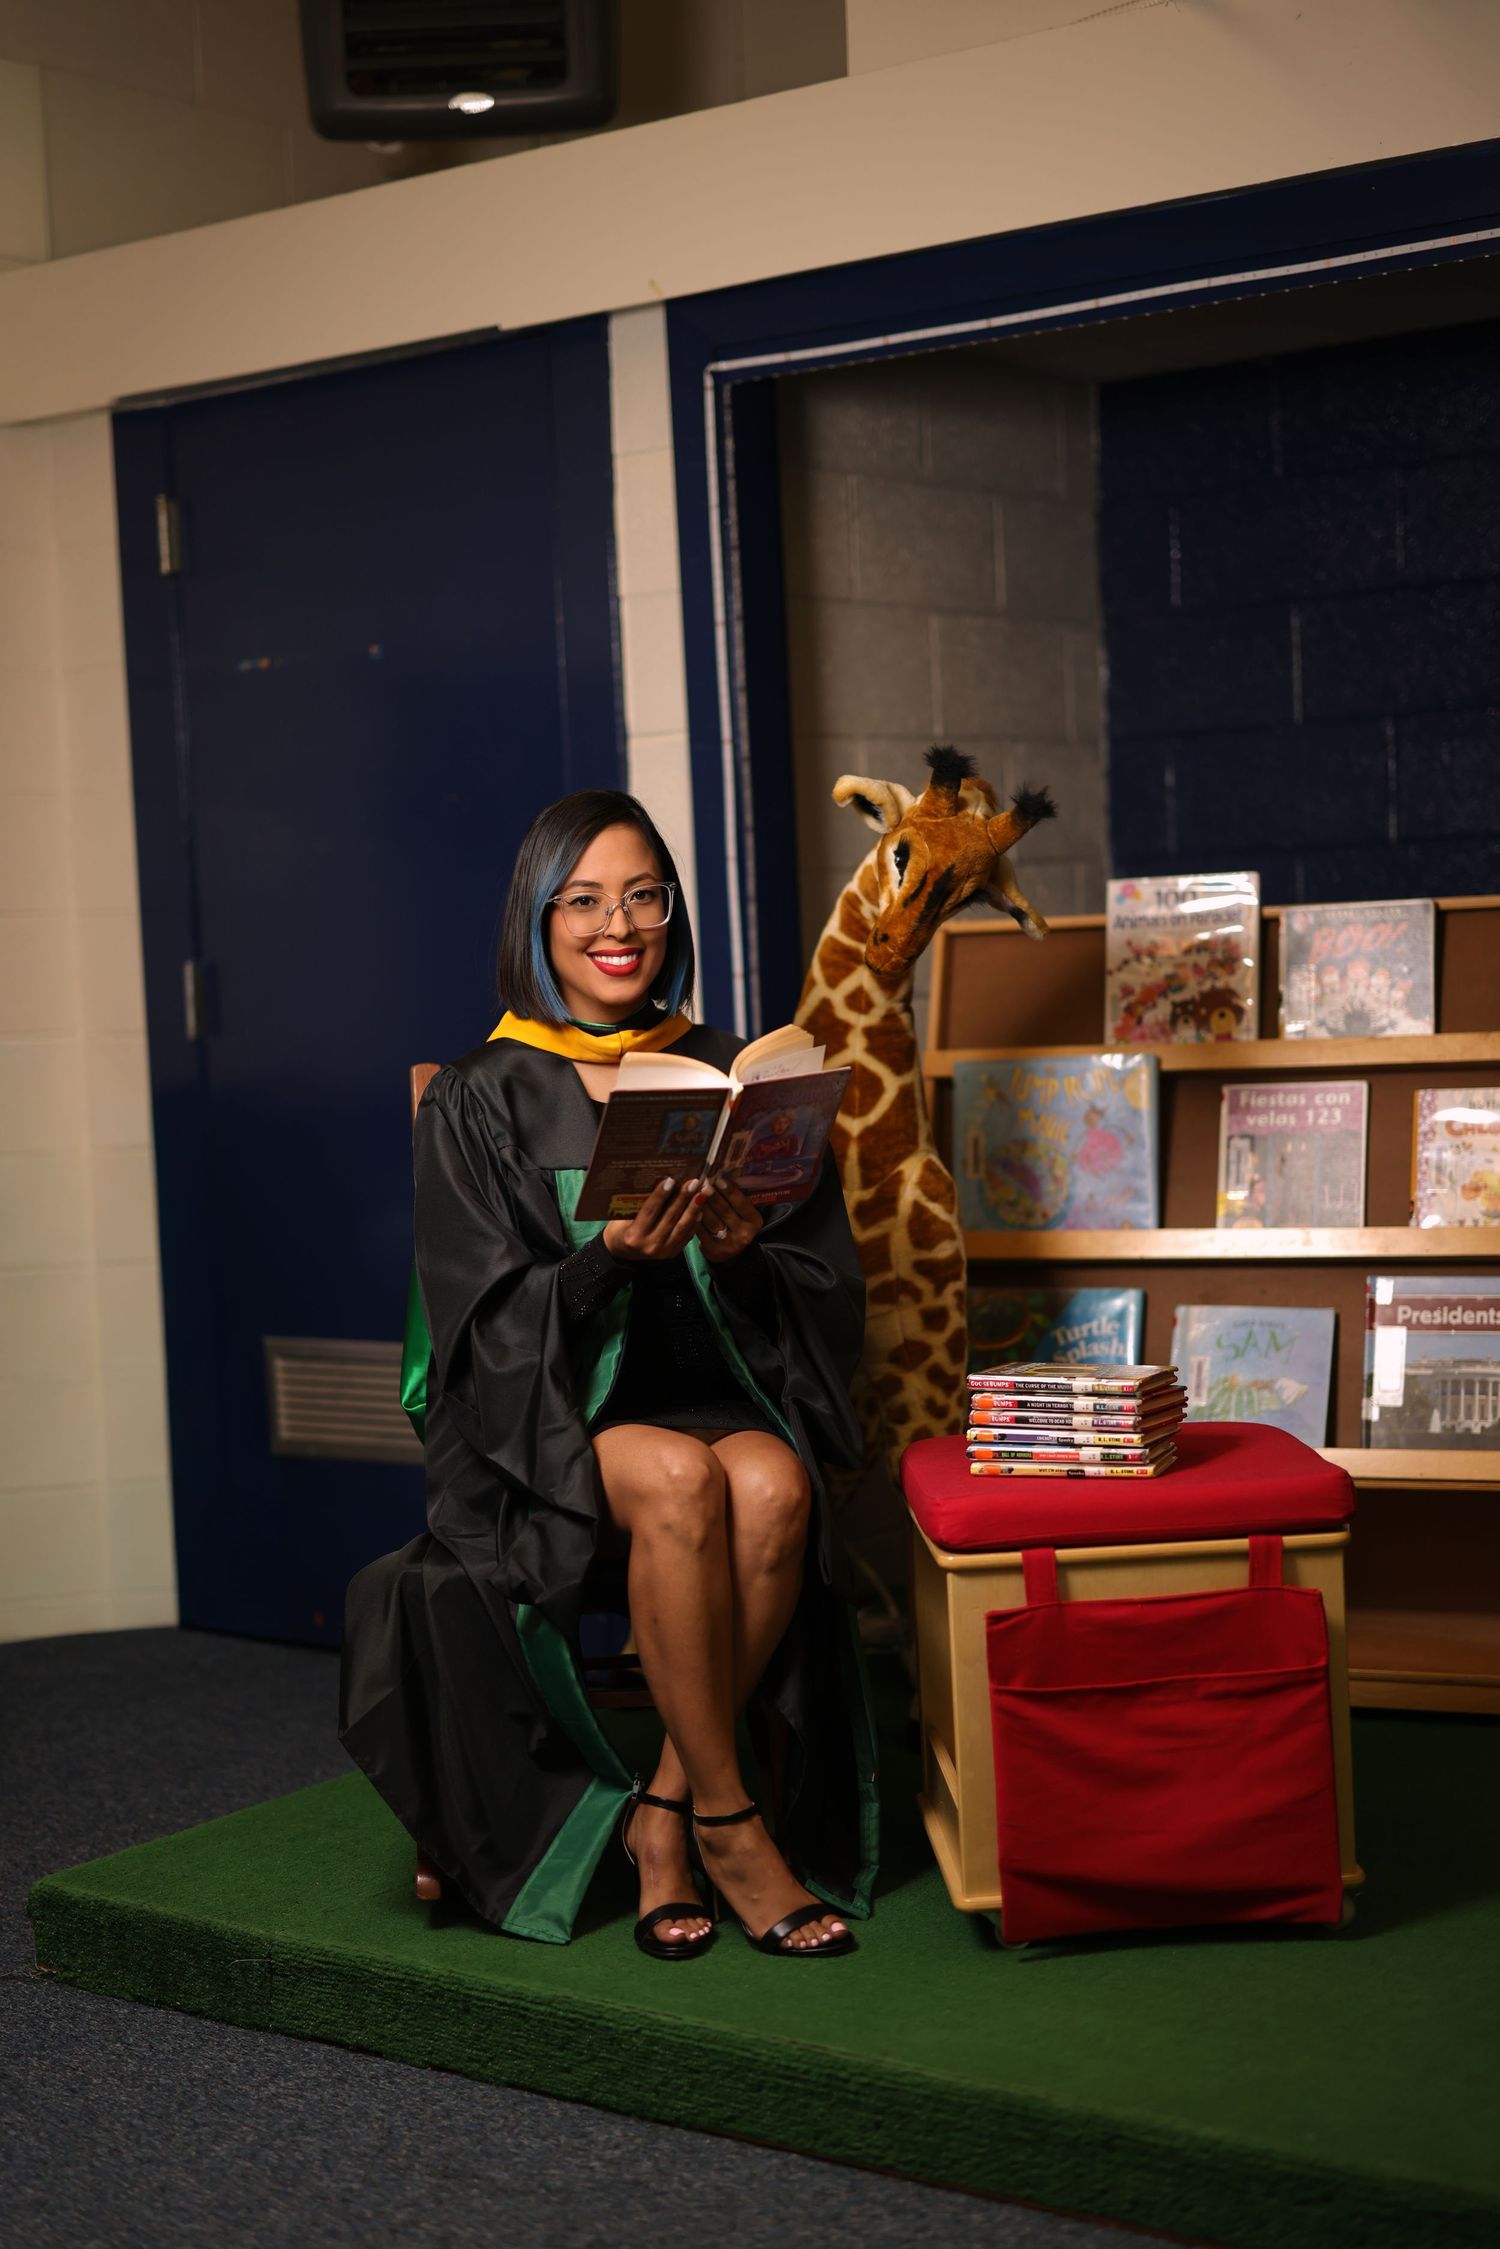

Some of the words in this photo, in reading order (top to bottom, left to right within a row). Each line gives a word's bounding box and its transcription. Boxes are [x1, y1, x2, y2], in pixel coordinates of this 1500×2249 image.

[1240, 1090, 1307, 1107] Fiestas
[1314, 1091, 1352, 1106] con
[1246, 1109, 1297, 1127] velas
[1396, 1304, 1500, 1326] Presidents
[1051, 1315, 1122, 1346] Turtle
[1215, 1327, 1301, 1365] SAM
